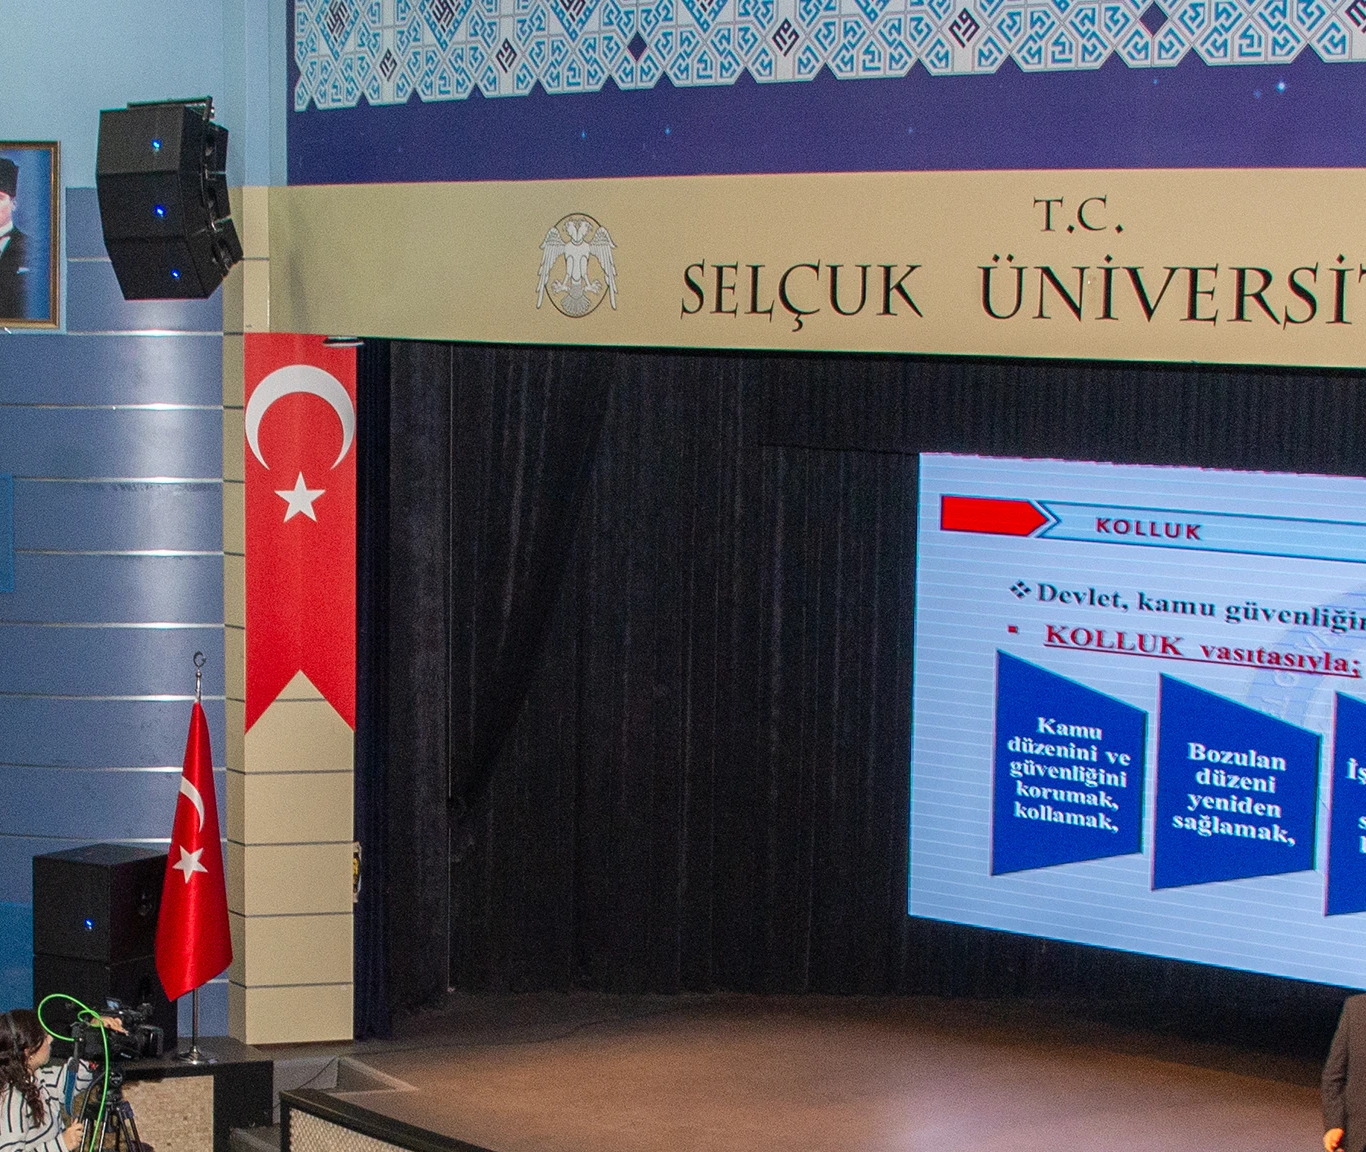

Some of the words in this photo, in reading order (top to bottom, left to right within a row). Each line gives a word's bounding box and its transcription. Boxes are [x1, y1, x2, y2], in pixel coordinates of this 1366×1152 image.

[1032, 194, 1125, 234] T.C.
[680, 258, 924, 332] SELÇUK
[1096, 517, 1202, 540] KOLLUK
[1038, 583, 1129, 612] Devlet,
[1137, 592, 1216, 617] kamu
[1045, 624, 1186, 656] KOLLUK
[1199, 642, 1362, 677] vasıtasıyla;
[1037, 717, 1103, 740] Kamu
[1007, 736, 1098, 762] düzenini
[1104, 751, 1131, 766] ve
[1187, 742, 1287, 771] Bozulan
[1009, 760, 1127, 788] güvenliğini
[1195, 768, 1277, 794] düzeni
[1016, 780, 1119, 811] korumak,
[1187, 794, 1282, 818] yeniden
[1014, 801, 1119, 834] kollamak,
[1172, 814, 1296, 848] sağlamak,
